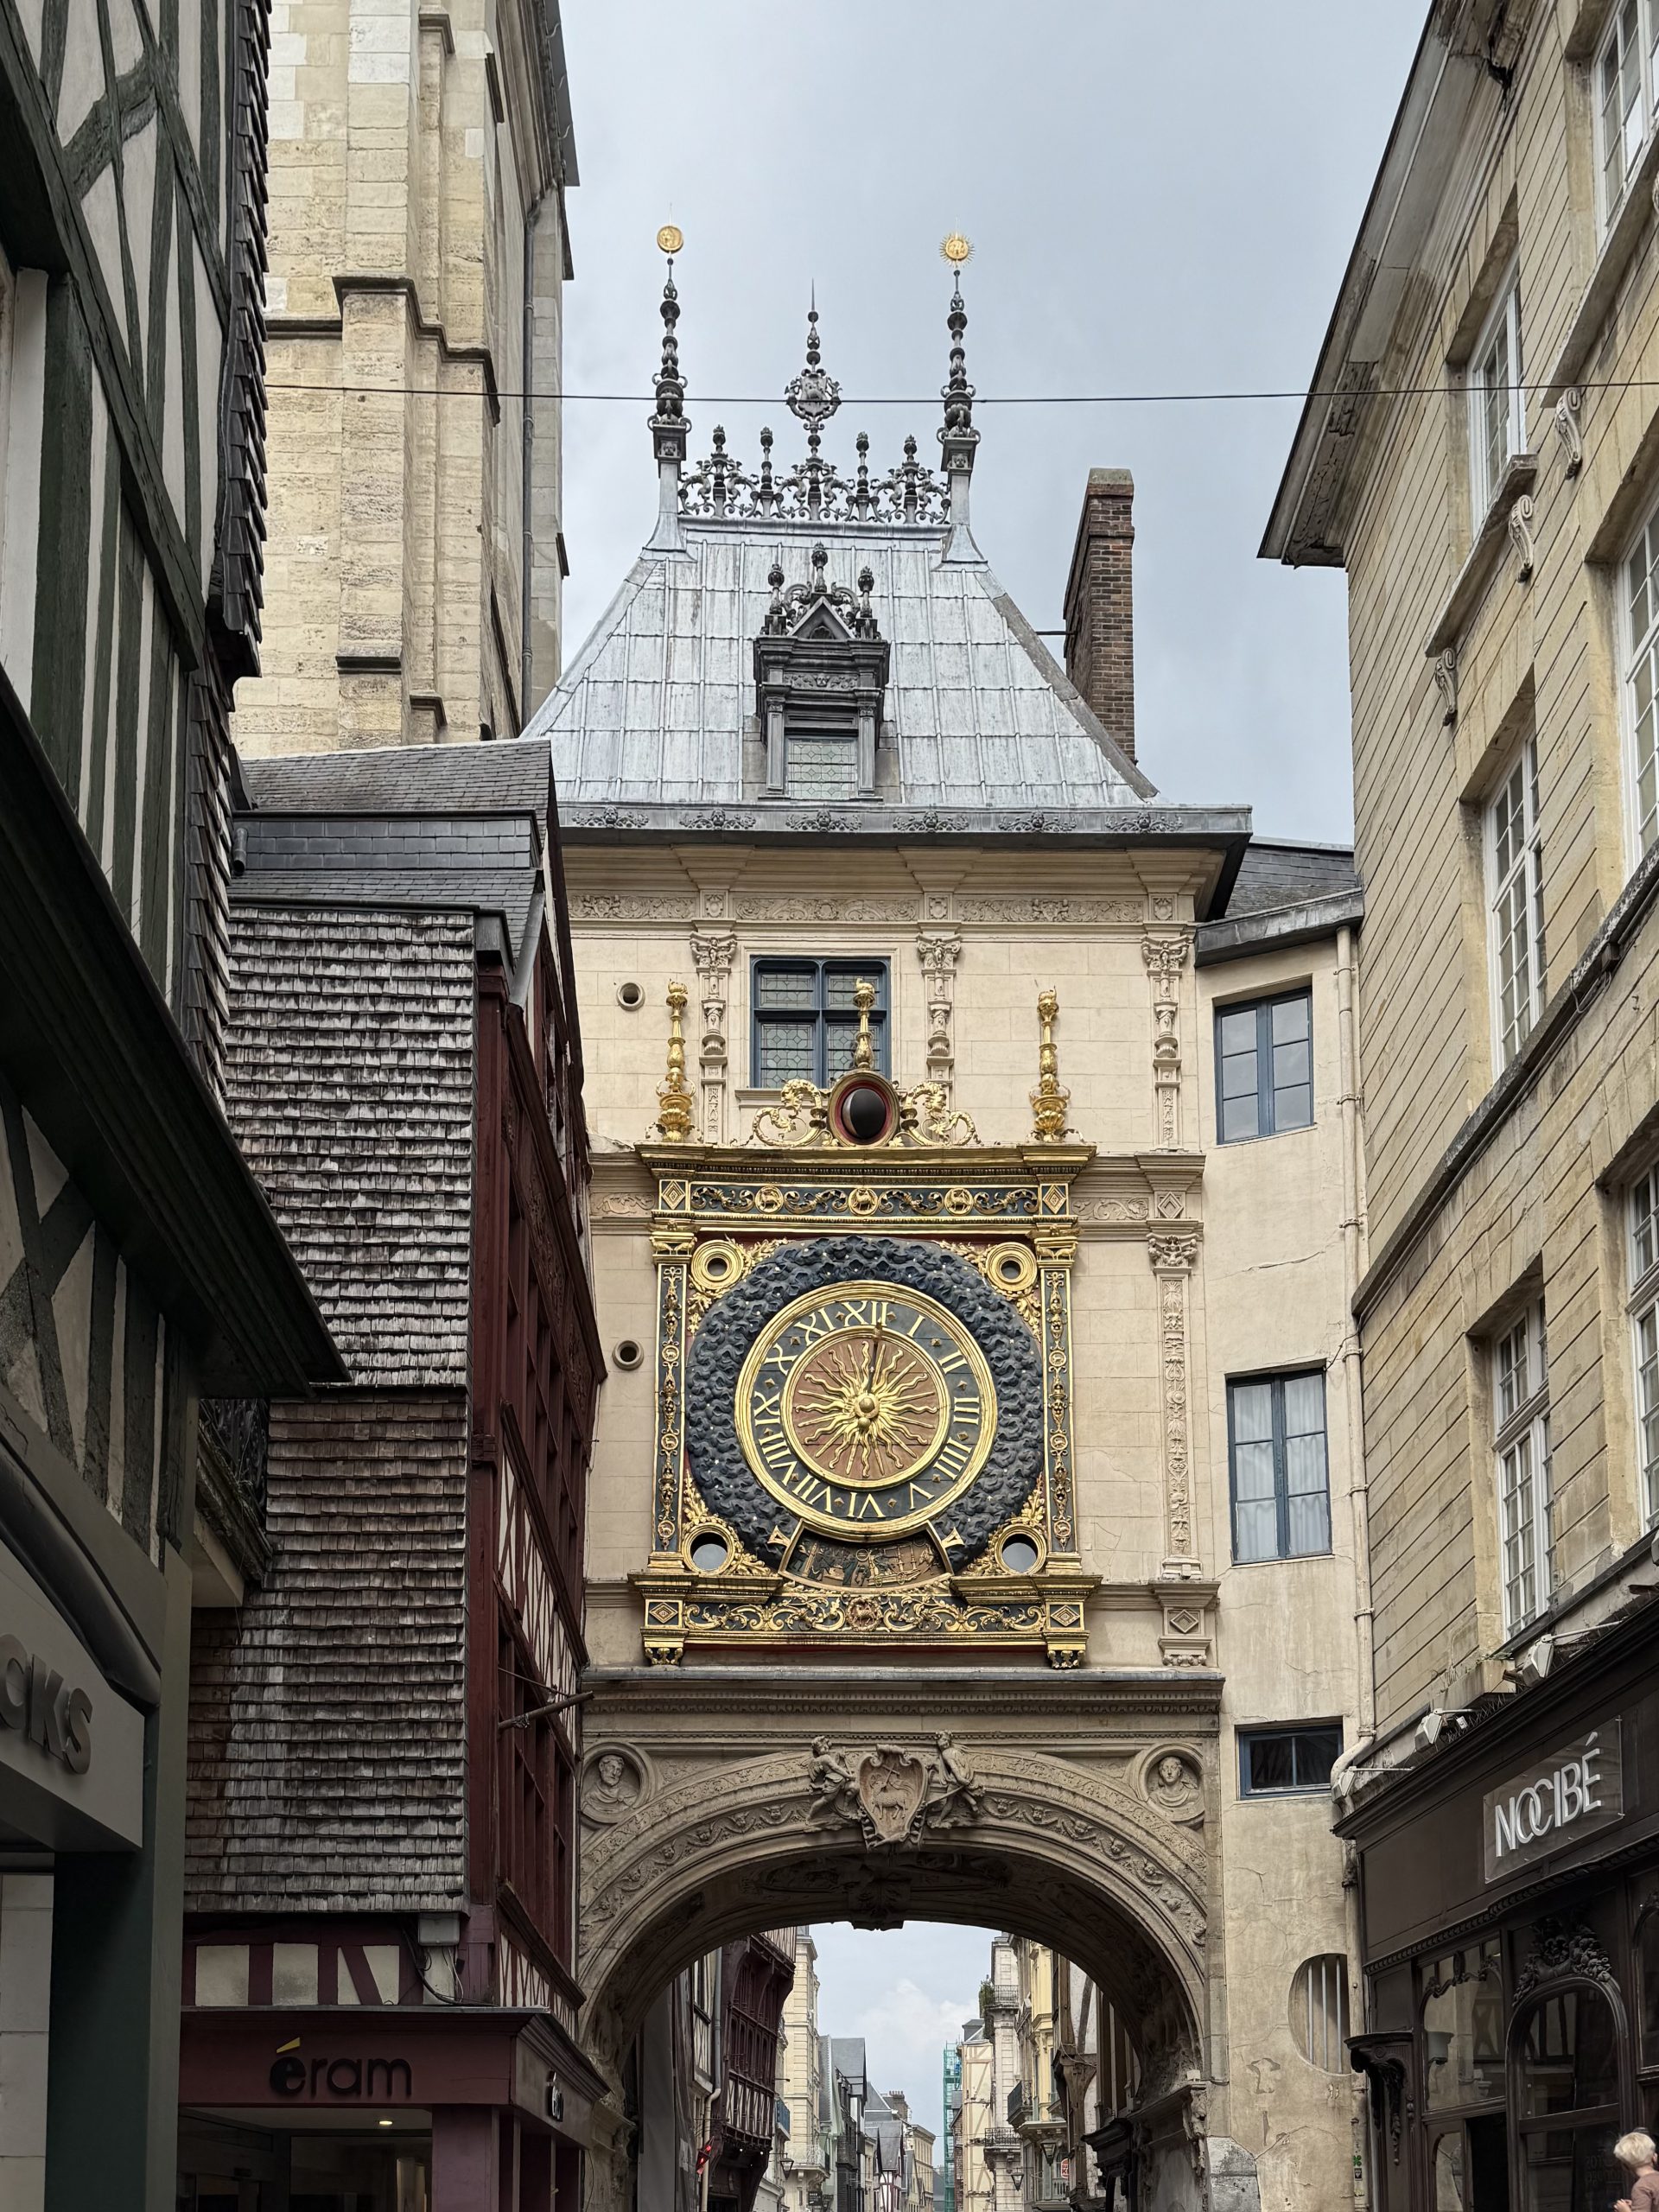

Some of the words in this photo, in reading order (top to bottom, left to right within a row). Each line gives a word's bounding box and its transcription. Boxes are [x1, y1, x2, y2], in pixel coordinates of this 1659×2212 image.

[793, 1307, 837, 1347] XI
[842, 1300, 888, 1327] XII
[906, 1314, 926, 1338] I
[763, 1343, 798, 1376] X
[938, 1350, 969, 1375] II
[753, 1390, 781, 1427] IX
[953, 1396, 980, 1426] III
[758, 1430, 798, 1486] VIII
[932, 1437, 974, 1480] IIII
[792, 1472, 834, 1514] VII
[847, 1491, 887, 1519] VI
[910, 1482, 935, 1510] V
[1494, 1731, 1602, 1857] NOCIBÉ
[270, 2037, 412, 2097] éram
